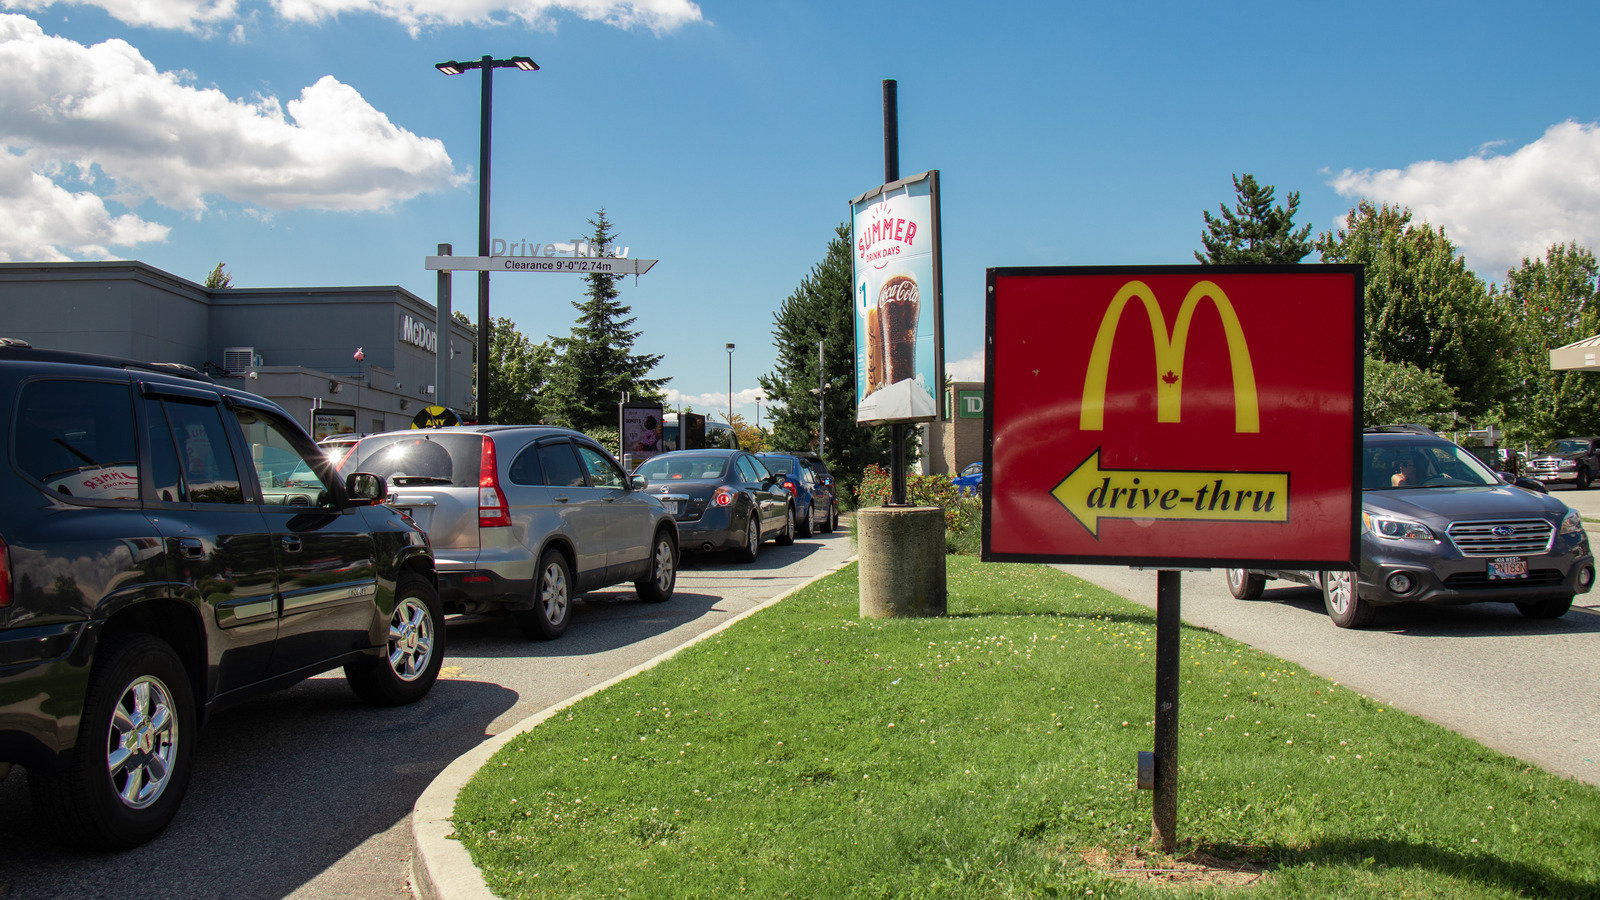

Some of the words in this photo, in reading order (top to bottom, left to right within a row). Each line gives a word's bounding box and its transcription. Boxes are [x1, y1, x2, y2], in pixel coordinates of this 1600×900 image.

[858, 218, 917, 258] SUMMER
[492, 238, 629, 259] Drive-Thru
[866, 250, 882, 263] DRINK
[883, 245, 901, 257] DAYS
[504, 260, 554, 270] Clearance
[556, 260, 612, 271] 9'-0"/2.74m
[963, 396, 984, 413] TD
[425, 418, 446, 426] ANY
[1086, 477, 1276, 513] drive-thru
